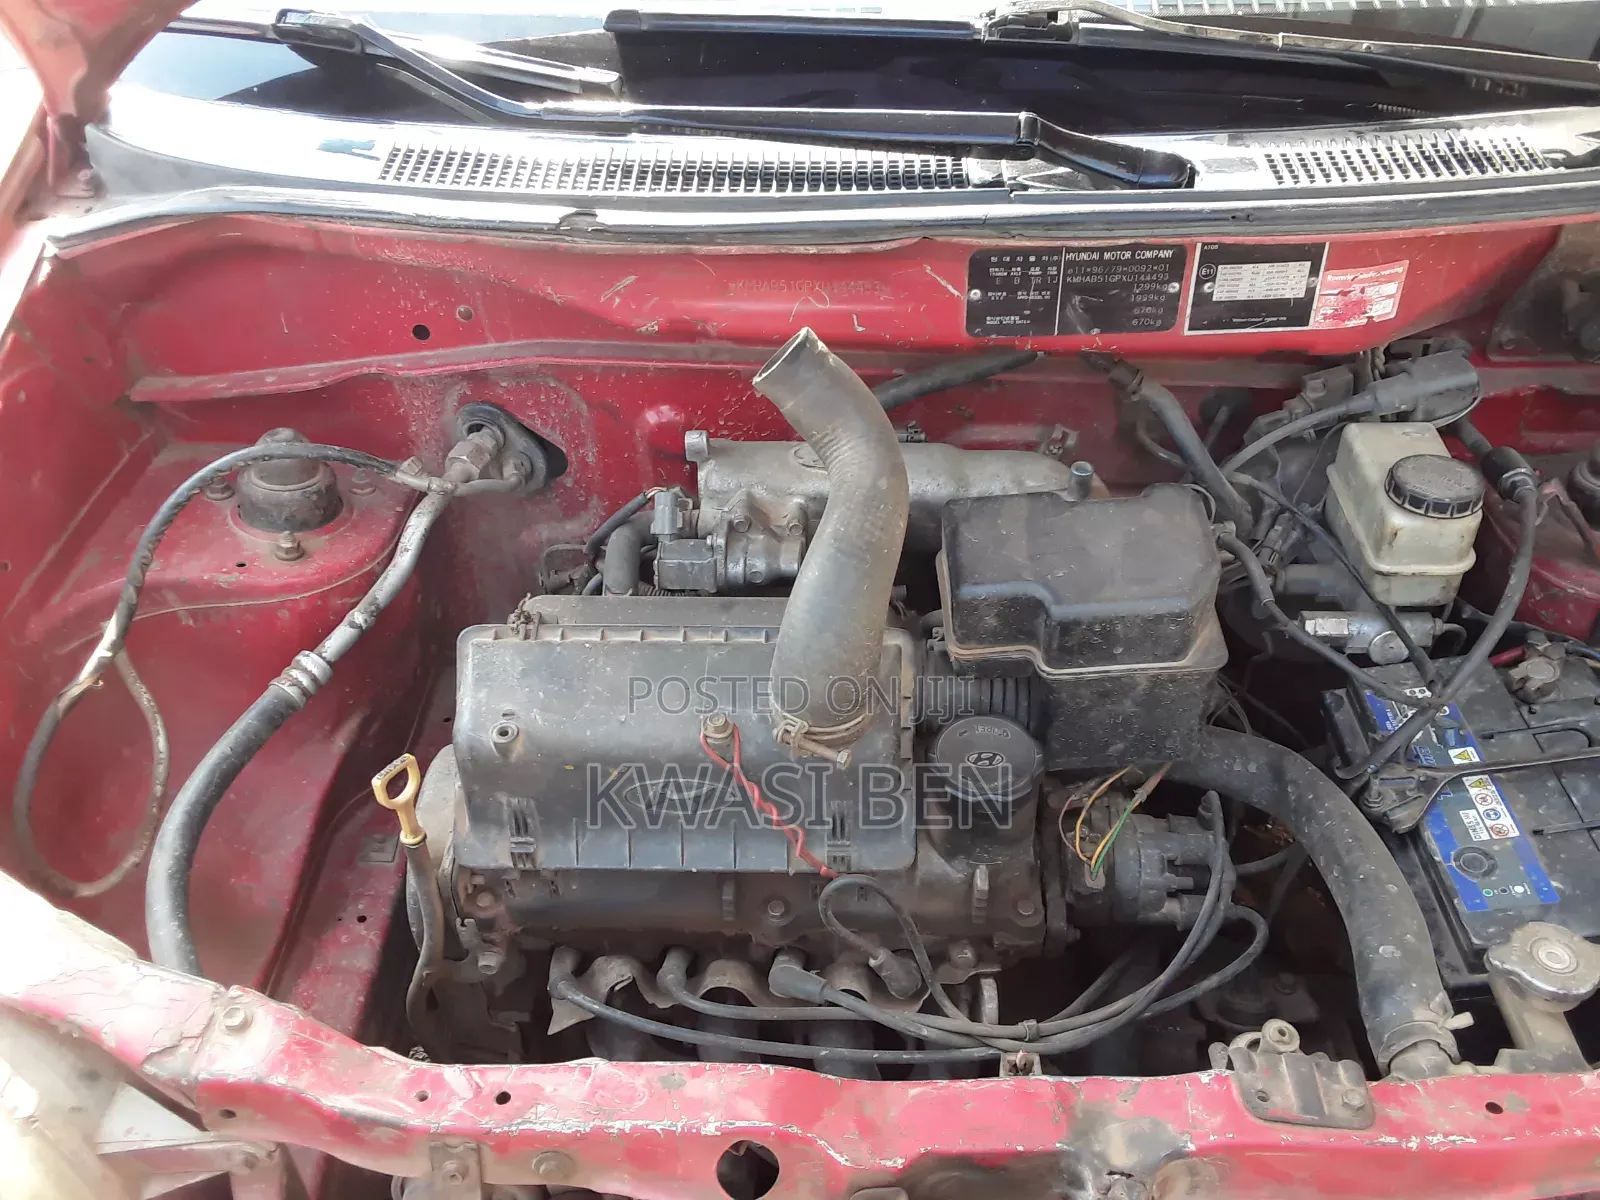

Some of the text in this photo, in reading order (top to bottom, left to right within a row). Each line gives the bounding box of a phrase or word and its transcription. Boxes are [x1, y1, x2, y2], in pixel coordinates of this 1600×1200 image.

[1065, 249, 1174, 261] HYUNDAI MOTOR COMPANY
